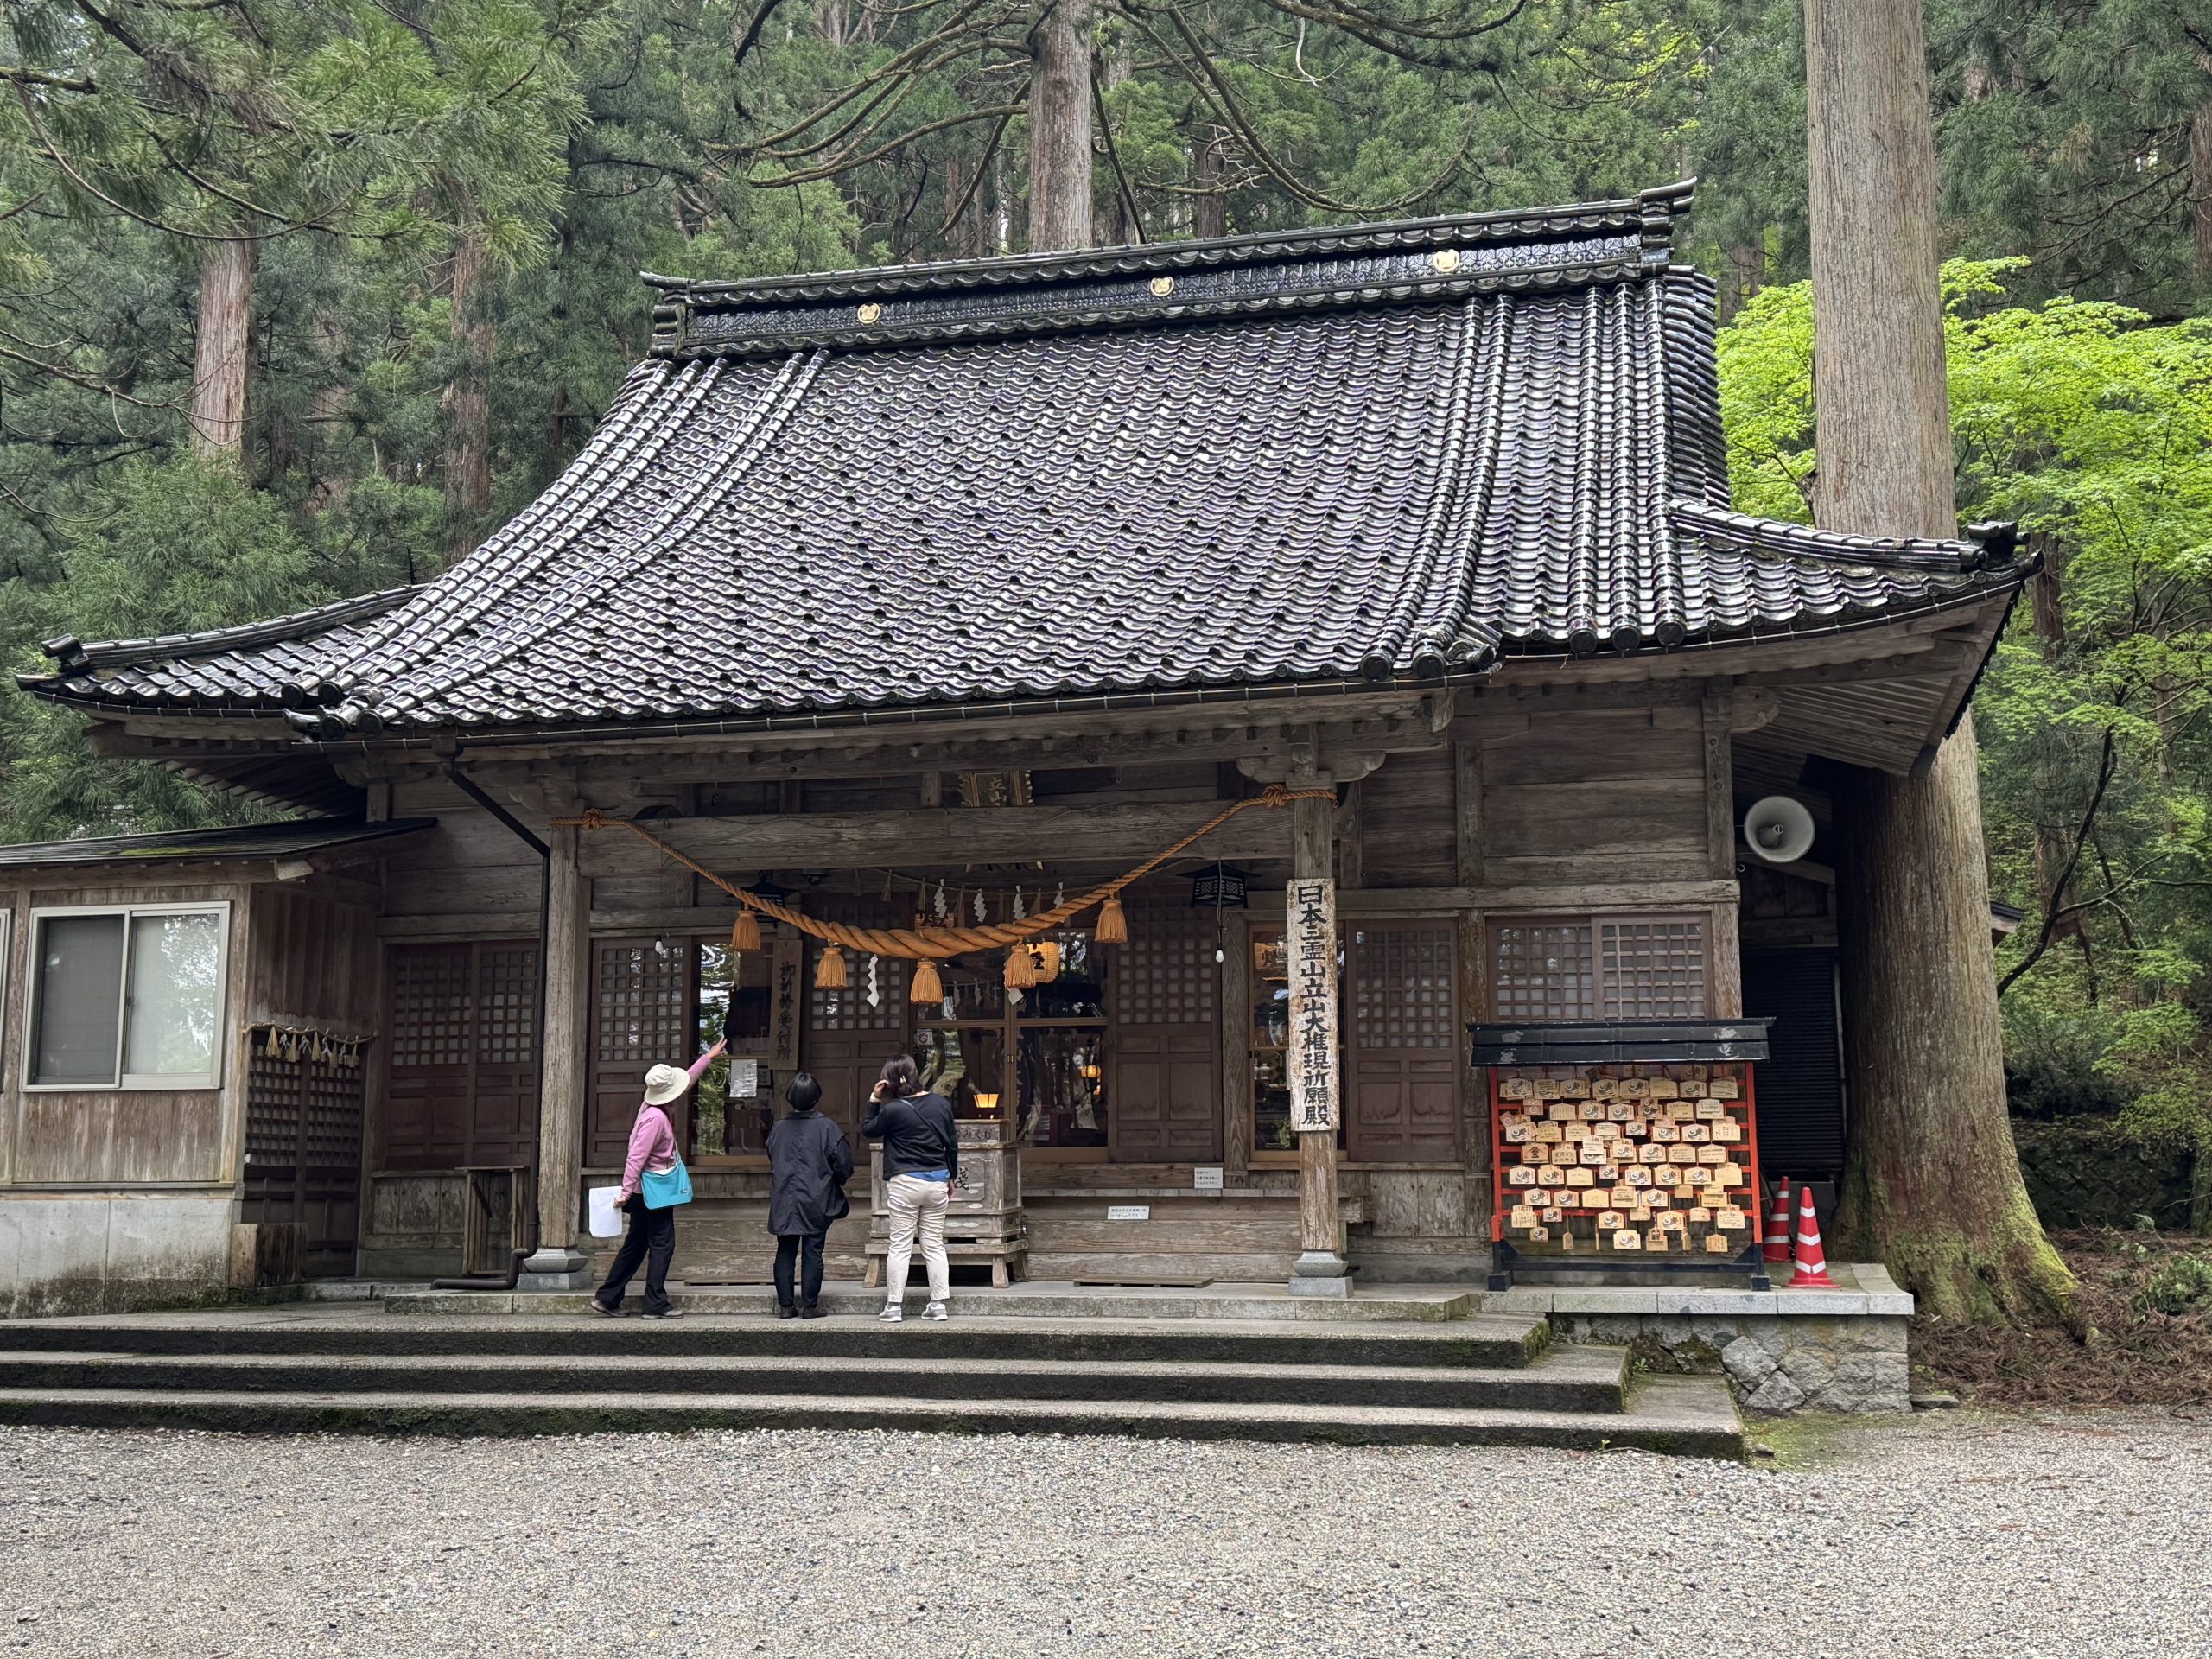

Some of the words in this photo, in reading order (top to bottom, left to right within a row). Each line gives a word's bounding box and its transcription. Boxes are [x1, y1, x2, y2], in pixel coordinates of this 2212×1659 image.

[988, 776, 1007, 807] 立山
[1297, 885, 1331, 1127] 日本三霊山立山大権現祈願殿
